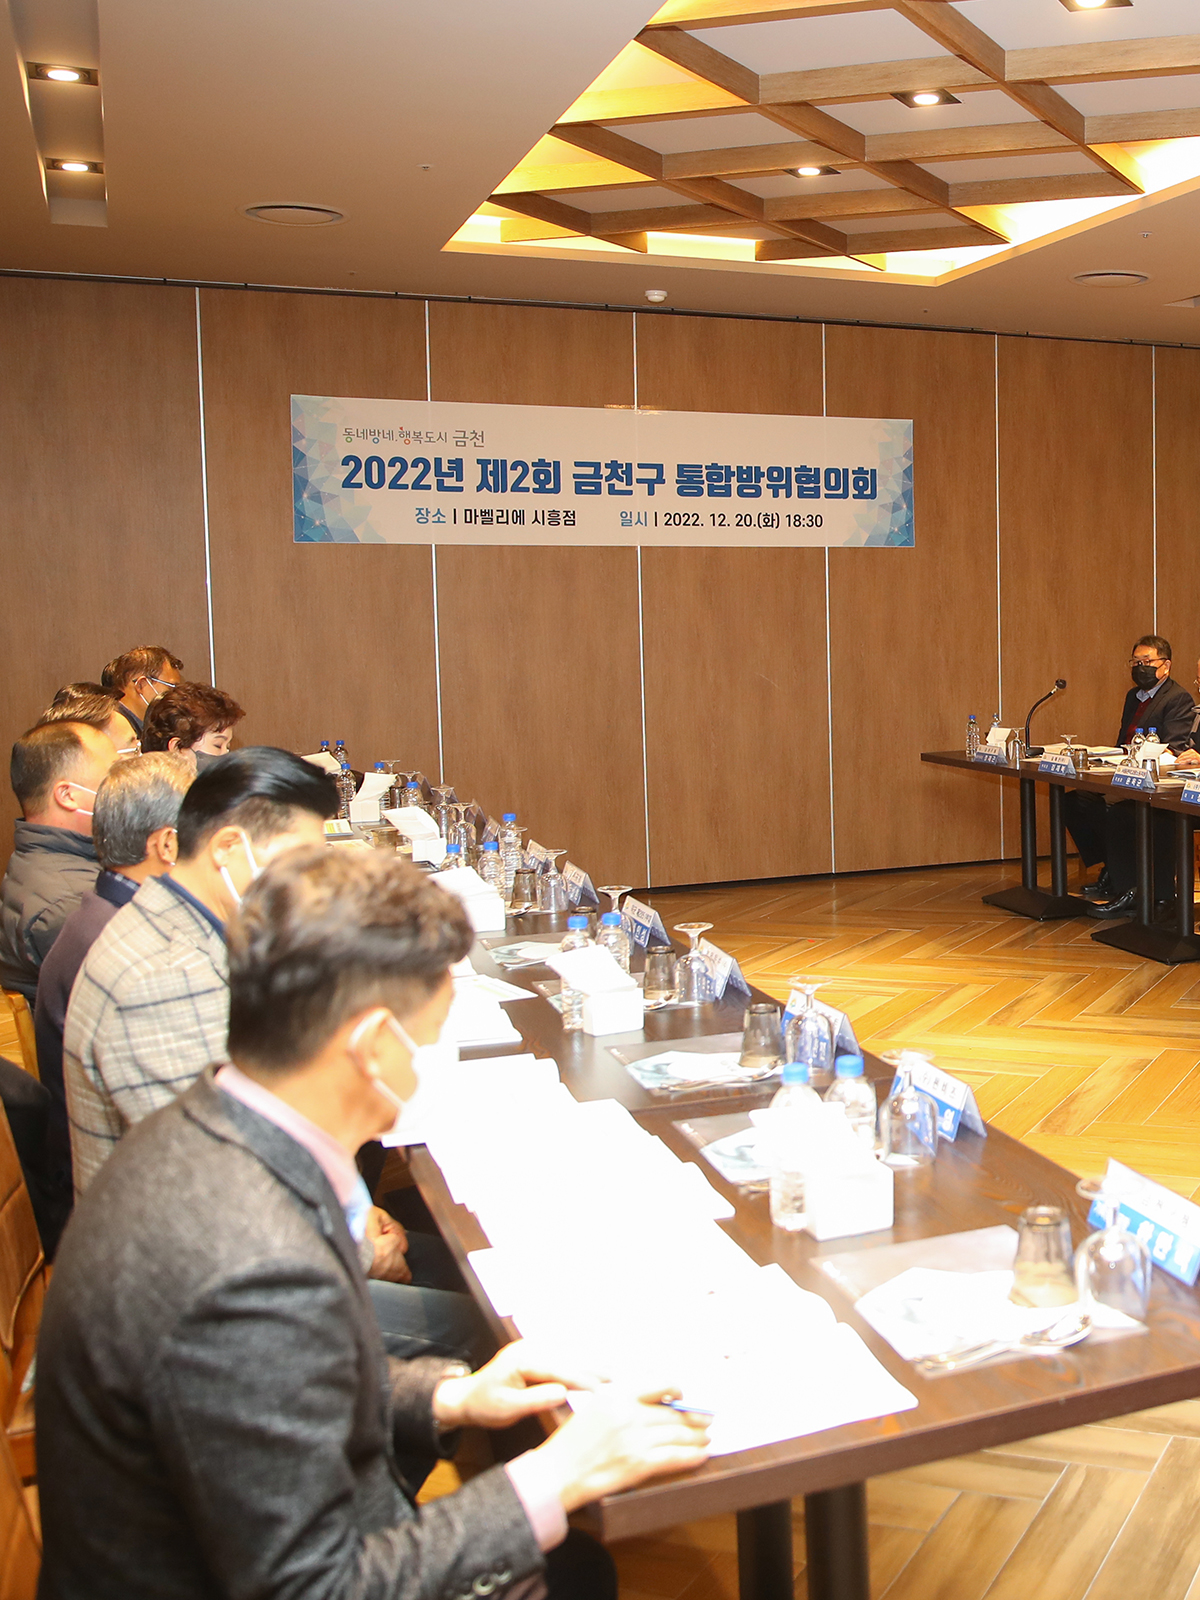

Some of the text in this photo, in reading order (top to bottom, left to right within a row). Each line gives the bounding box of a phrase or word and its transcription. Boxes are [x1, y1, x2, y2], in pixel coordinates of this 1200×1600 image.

[399, 426, 448, 445] 행복도시
[453, 429, 485, 448] 금천
[341, 454, 878, 501] 2022년 제2회 금천구 통합방위협의회
[415, 507, 576, 527] 장소 마벨리에 시흥점
[619, 510, 823, 529] 일시 2022. 12. 20.(화) 18:30
